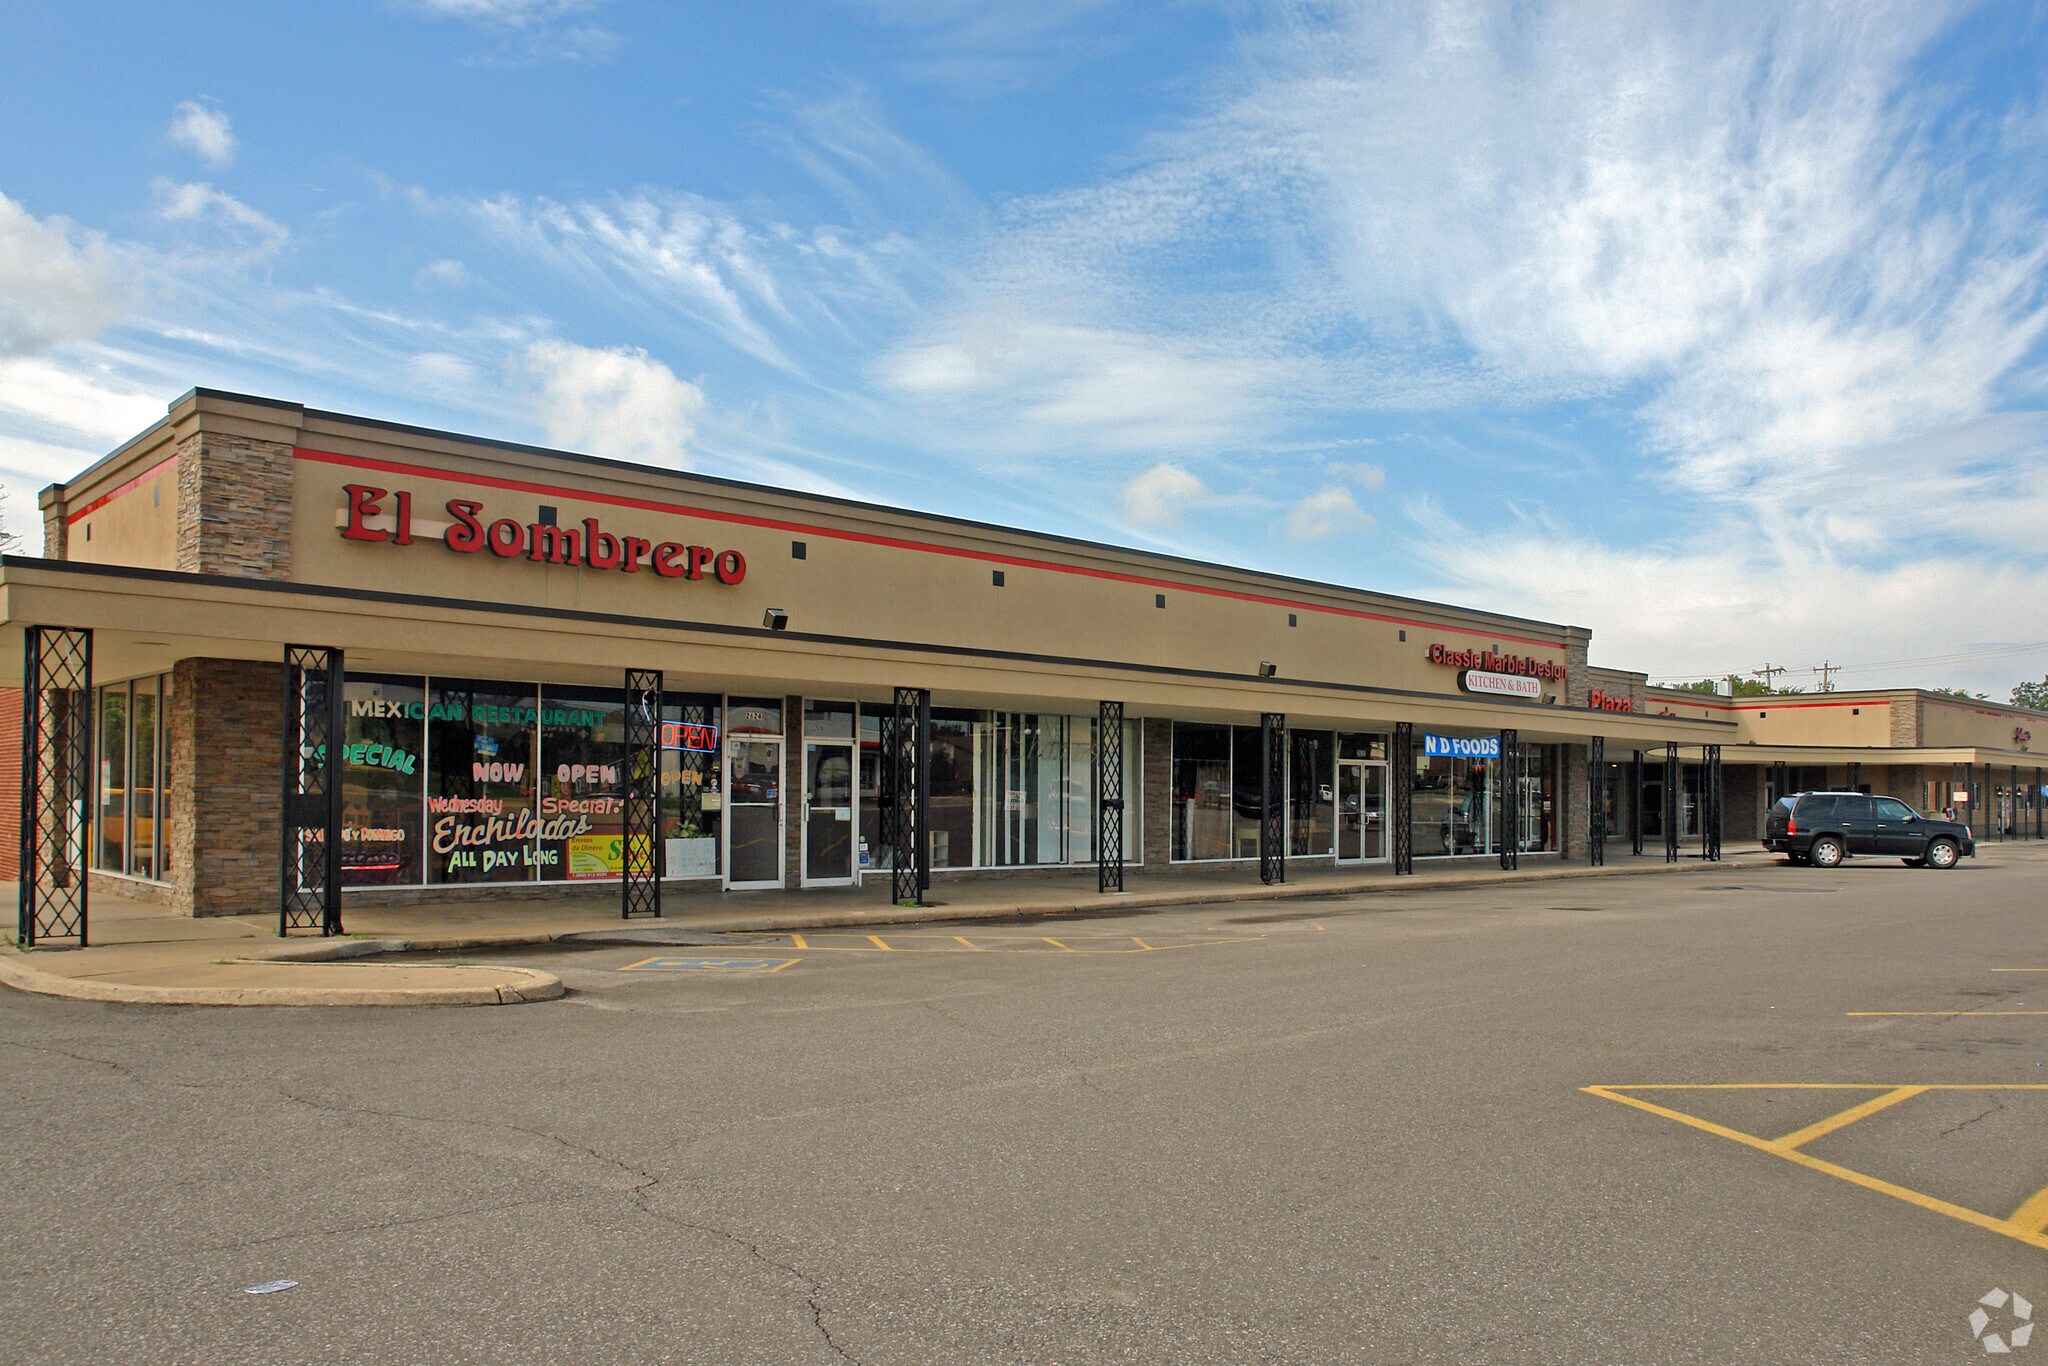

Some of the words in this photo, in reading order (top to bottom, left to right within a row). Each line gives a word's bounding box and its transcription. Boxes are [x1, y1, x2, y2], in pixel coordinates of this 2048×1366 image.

[341, 483, 413, 546] El
[443, 498, 746, 585] Sombrero
[1430, 643, 1481, 669] Classic
[1483, 650, 1526, 674] Marble
[1526, 657, 1568, 683] Design
[1468, 674, 1507, 691] KITCHEN
[1507, 679, 1515, 691] &
[1516, 680, 1539, 693] BATH
[351, 699, 463, 721] MEXICAN
[472, 704, 608, 727] RESTAURANT
[1589, 688, 1632, 713] Plaza
[661, 723, 715, 750] OPEN
[1425, 735, 1436, 753] N
[1440, 737, 1451, 754] D
[1453, 738, 1499, 755] FOODS
[473, 762, 524, 783] NOW
[557, 764, 616, 784] OPEN
[661, 769, 703, 786] OPEN
[428, 794, 503, 816] Wednesday
[433, 807, 592, 854] Enchiladas
[448, 851, 477, 873] ALL
[483, 851, 519, 873] DAY
[523, 845, 559, 867] LONG
